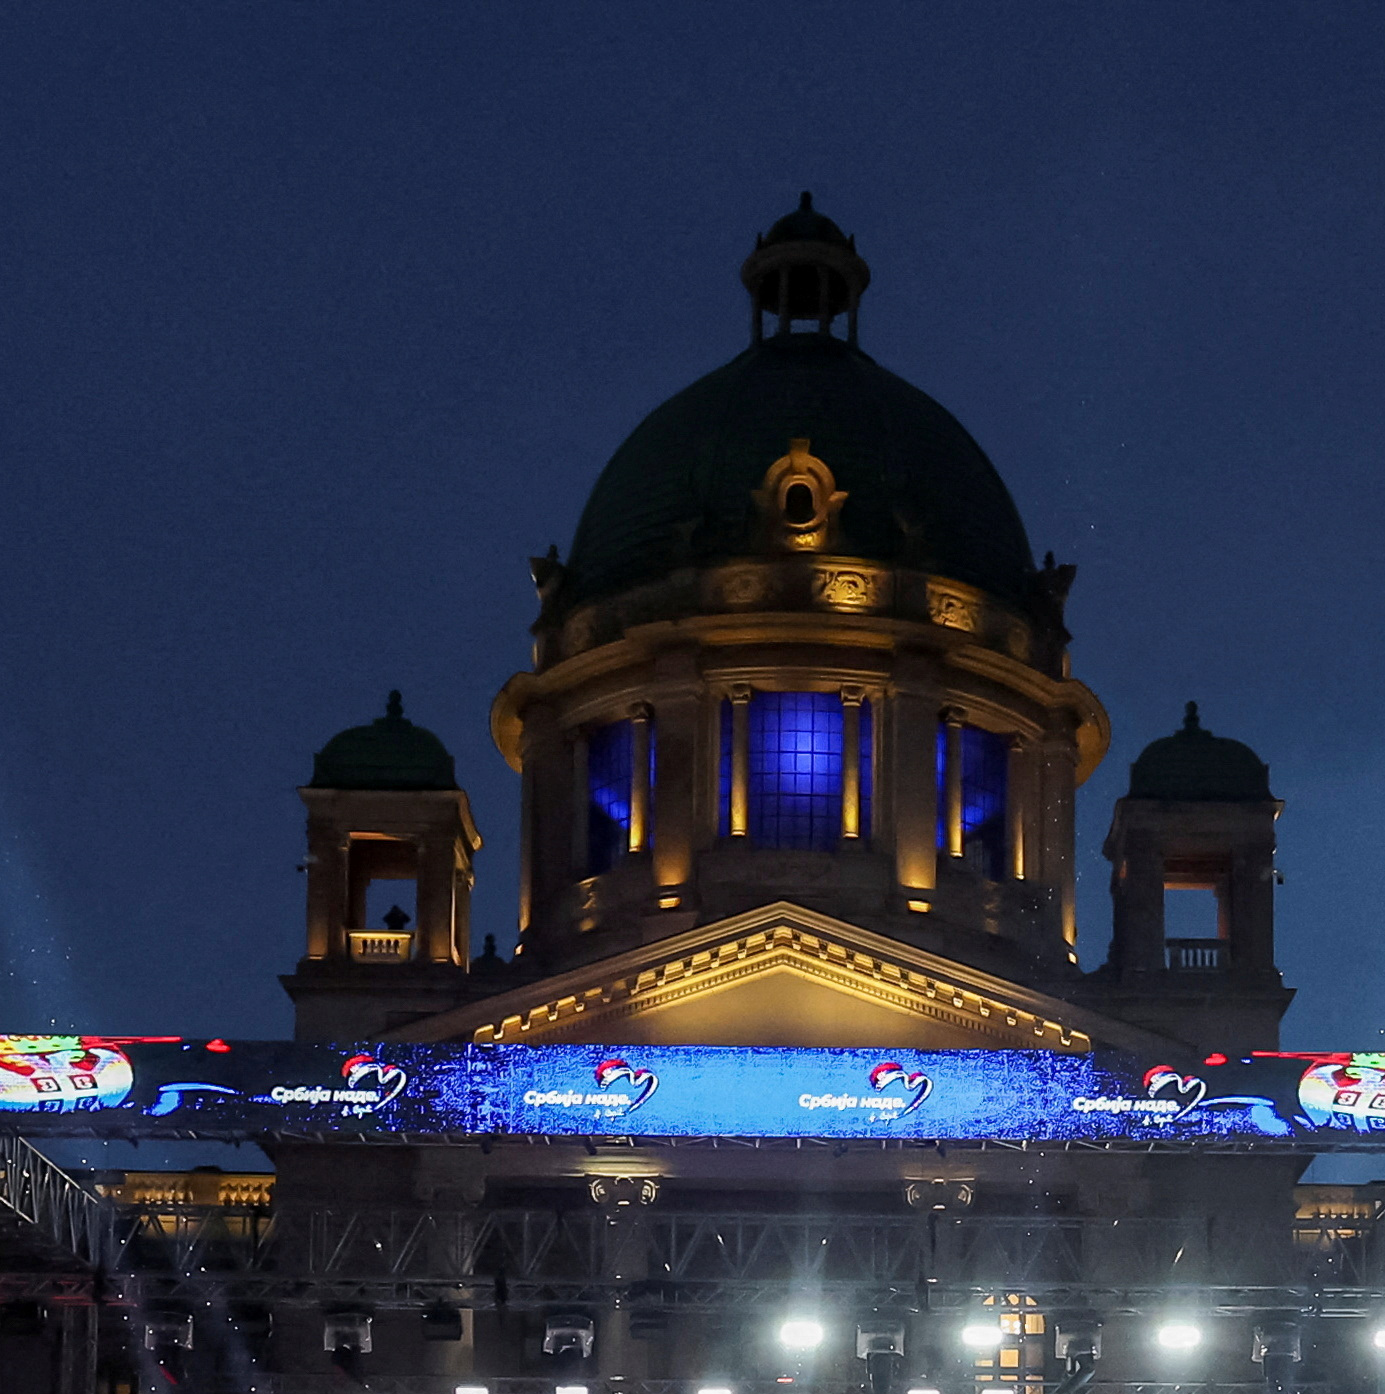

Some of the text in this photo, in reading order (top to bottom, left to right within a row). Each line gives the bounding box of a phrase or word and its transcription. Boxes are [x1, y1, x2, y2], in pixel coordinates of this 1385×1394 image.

[271, 1086, 331, 1104] Србија
[523, 1089, 583, 1107] Србија
[798, 1093, 857, 1110] Србија
[1073, 1095, 1131, 1113] Србија
